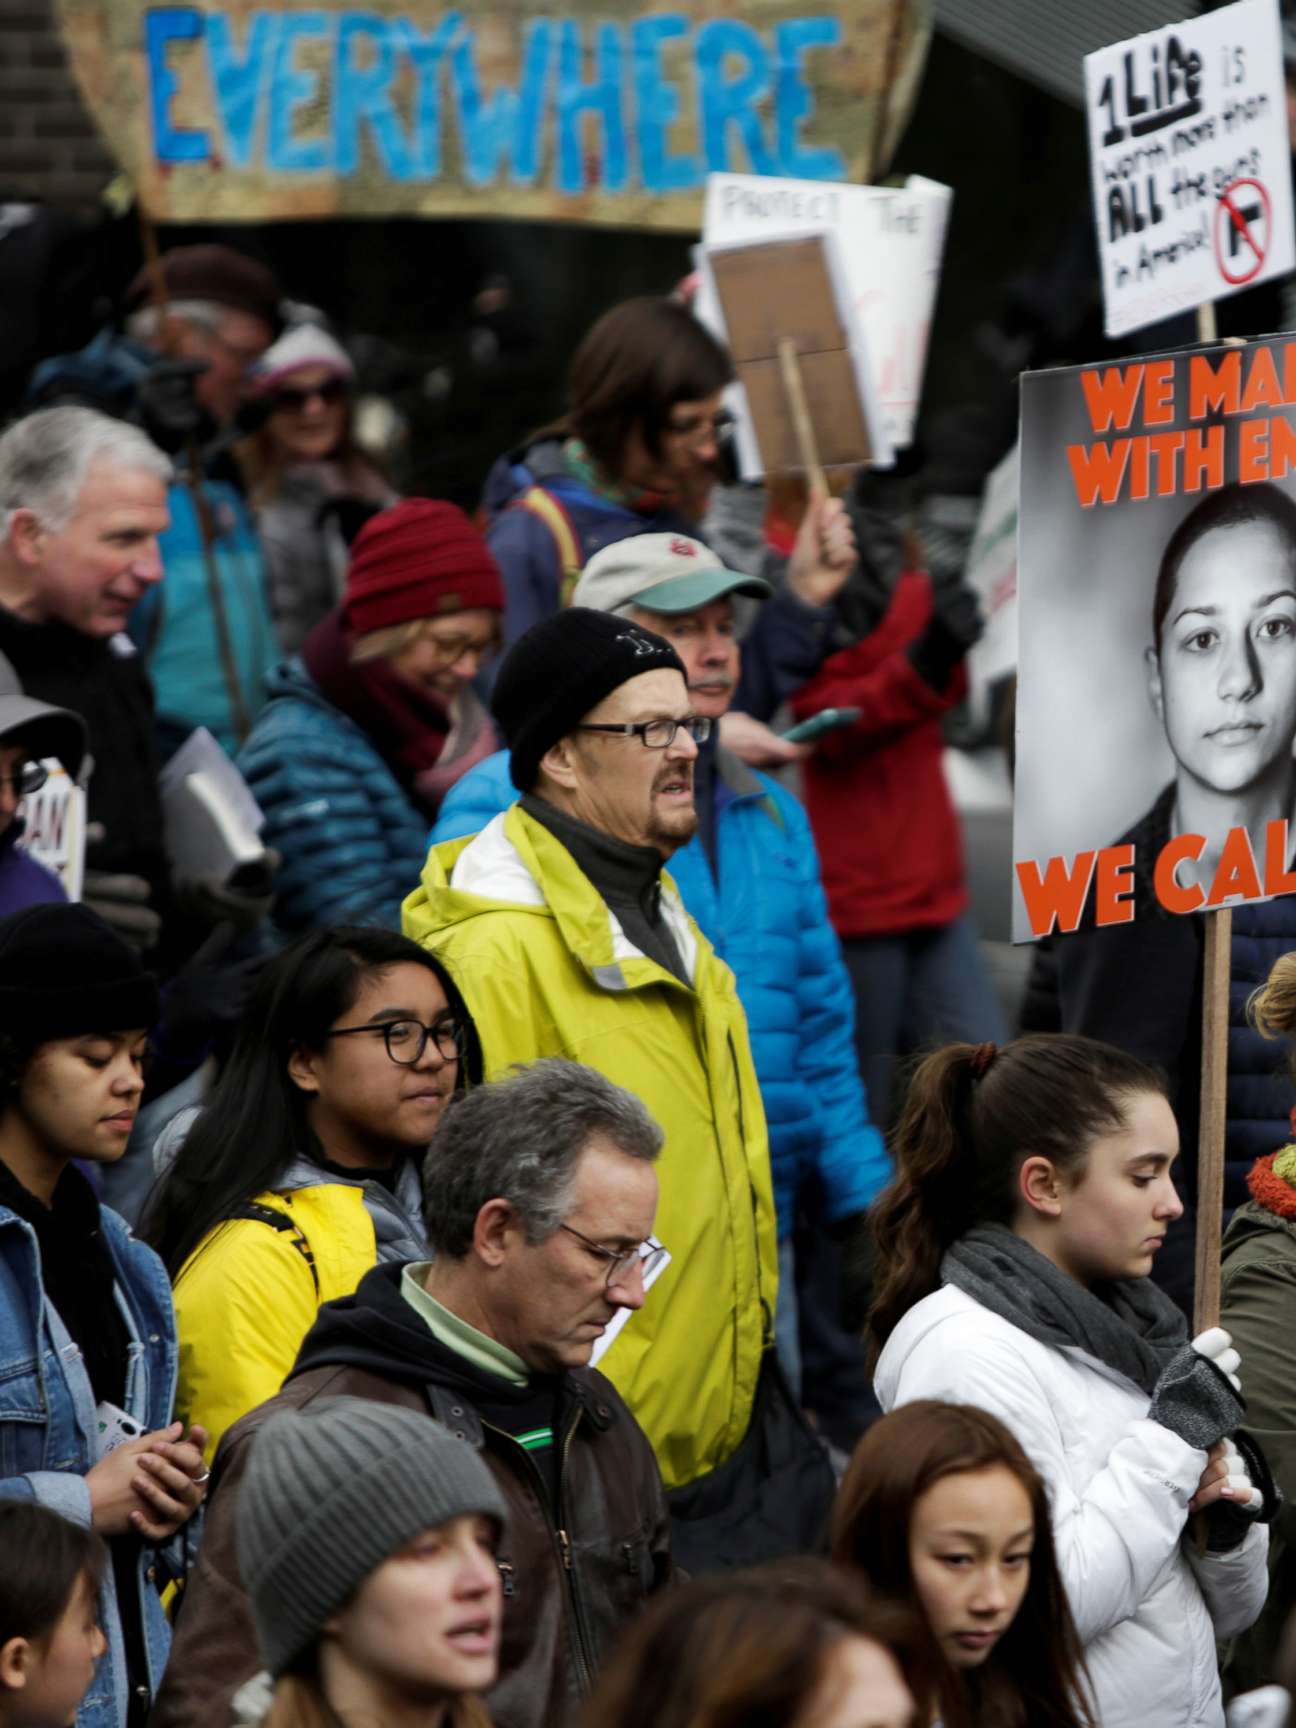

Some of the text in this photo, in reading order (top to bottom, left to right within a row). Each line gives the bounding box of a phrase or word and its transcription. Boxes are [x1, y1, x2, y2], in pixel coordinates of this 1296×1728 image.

[146, 8, 848, 192] EVERYWHERE
[1099, 74, 1124, 147] 1
[1107, 172, 1163, 244] ALL
[1170, 165, 1207, 210] the
[1080, 359, 1176, 433] WE
[1066, 424, 1226, 507] WITH
[1015, 844, 1136, 938] WE
